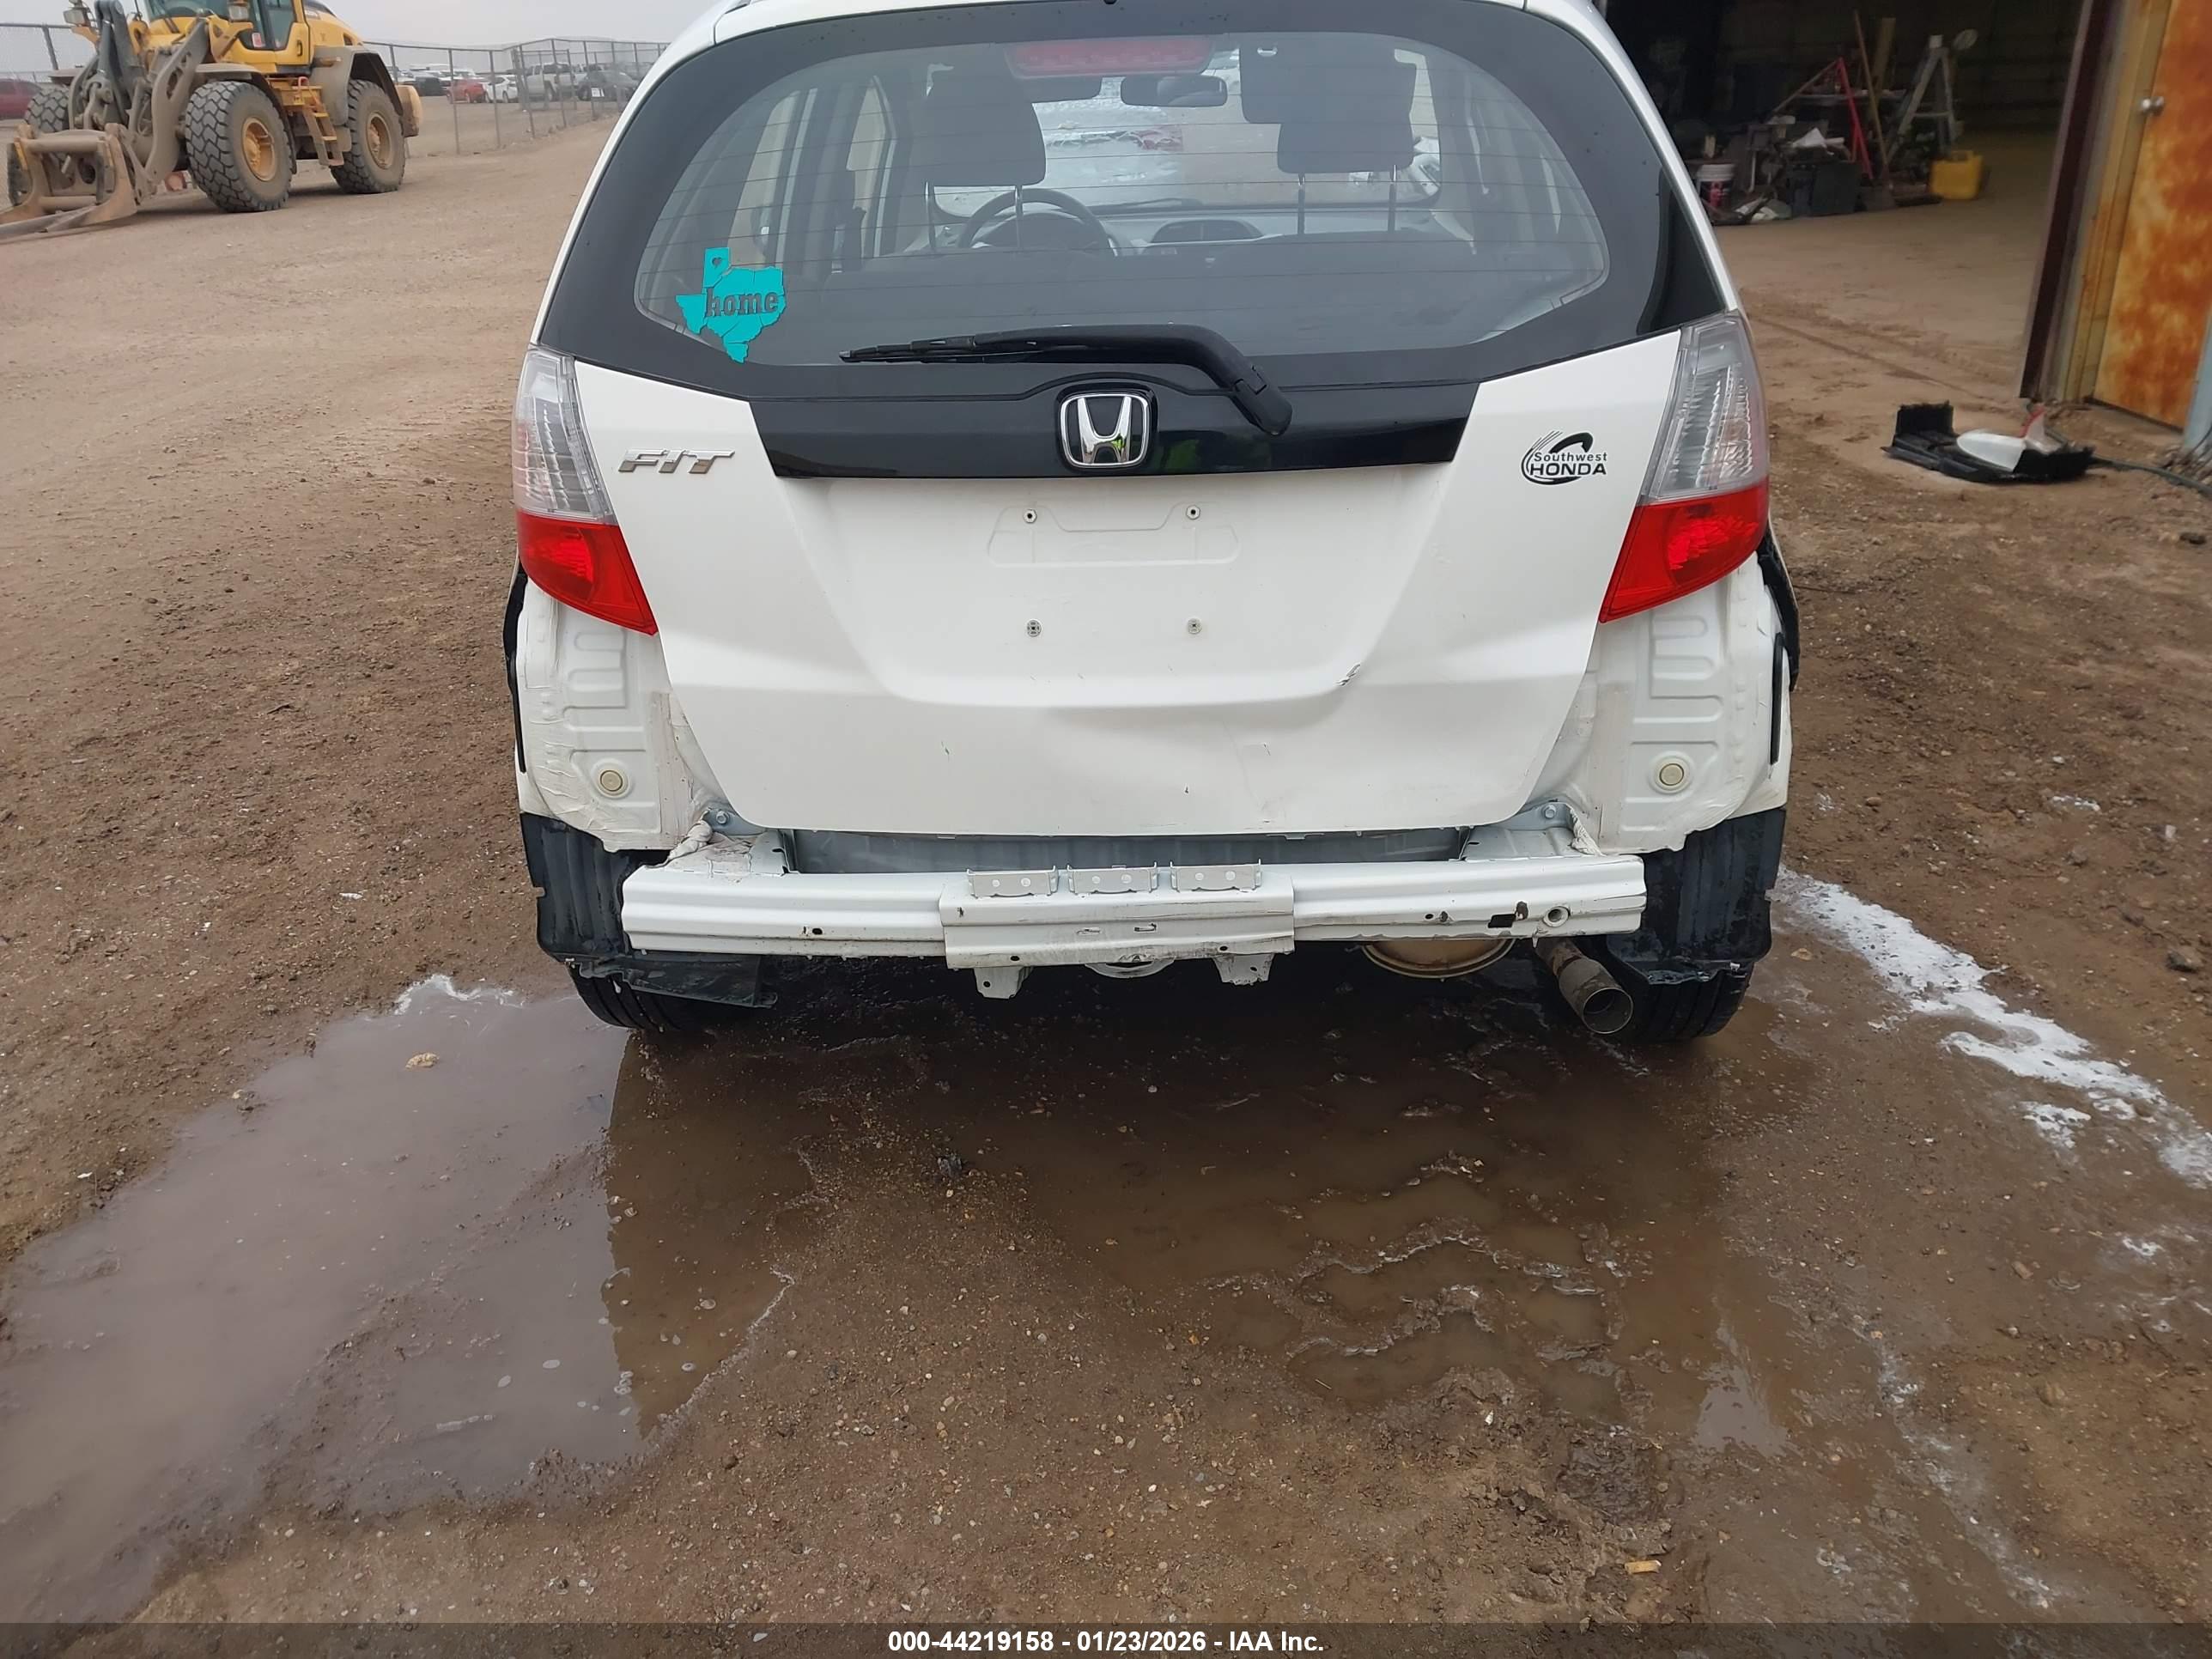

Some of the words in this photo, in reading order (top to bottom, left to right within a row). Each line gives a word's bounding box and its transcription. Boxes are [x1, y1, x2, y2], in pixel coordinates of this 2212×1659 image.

[706, 287, 779, 317] home
[618, 448, 735, 474] FIT
[1534, 452, 1607, 462] Southwest
[1530, 462, 1607, 476] HONDA
